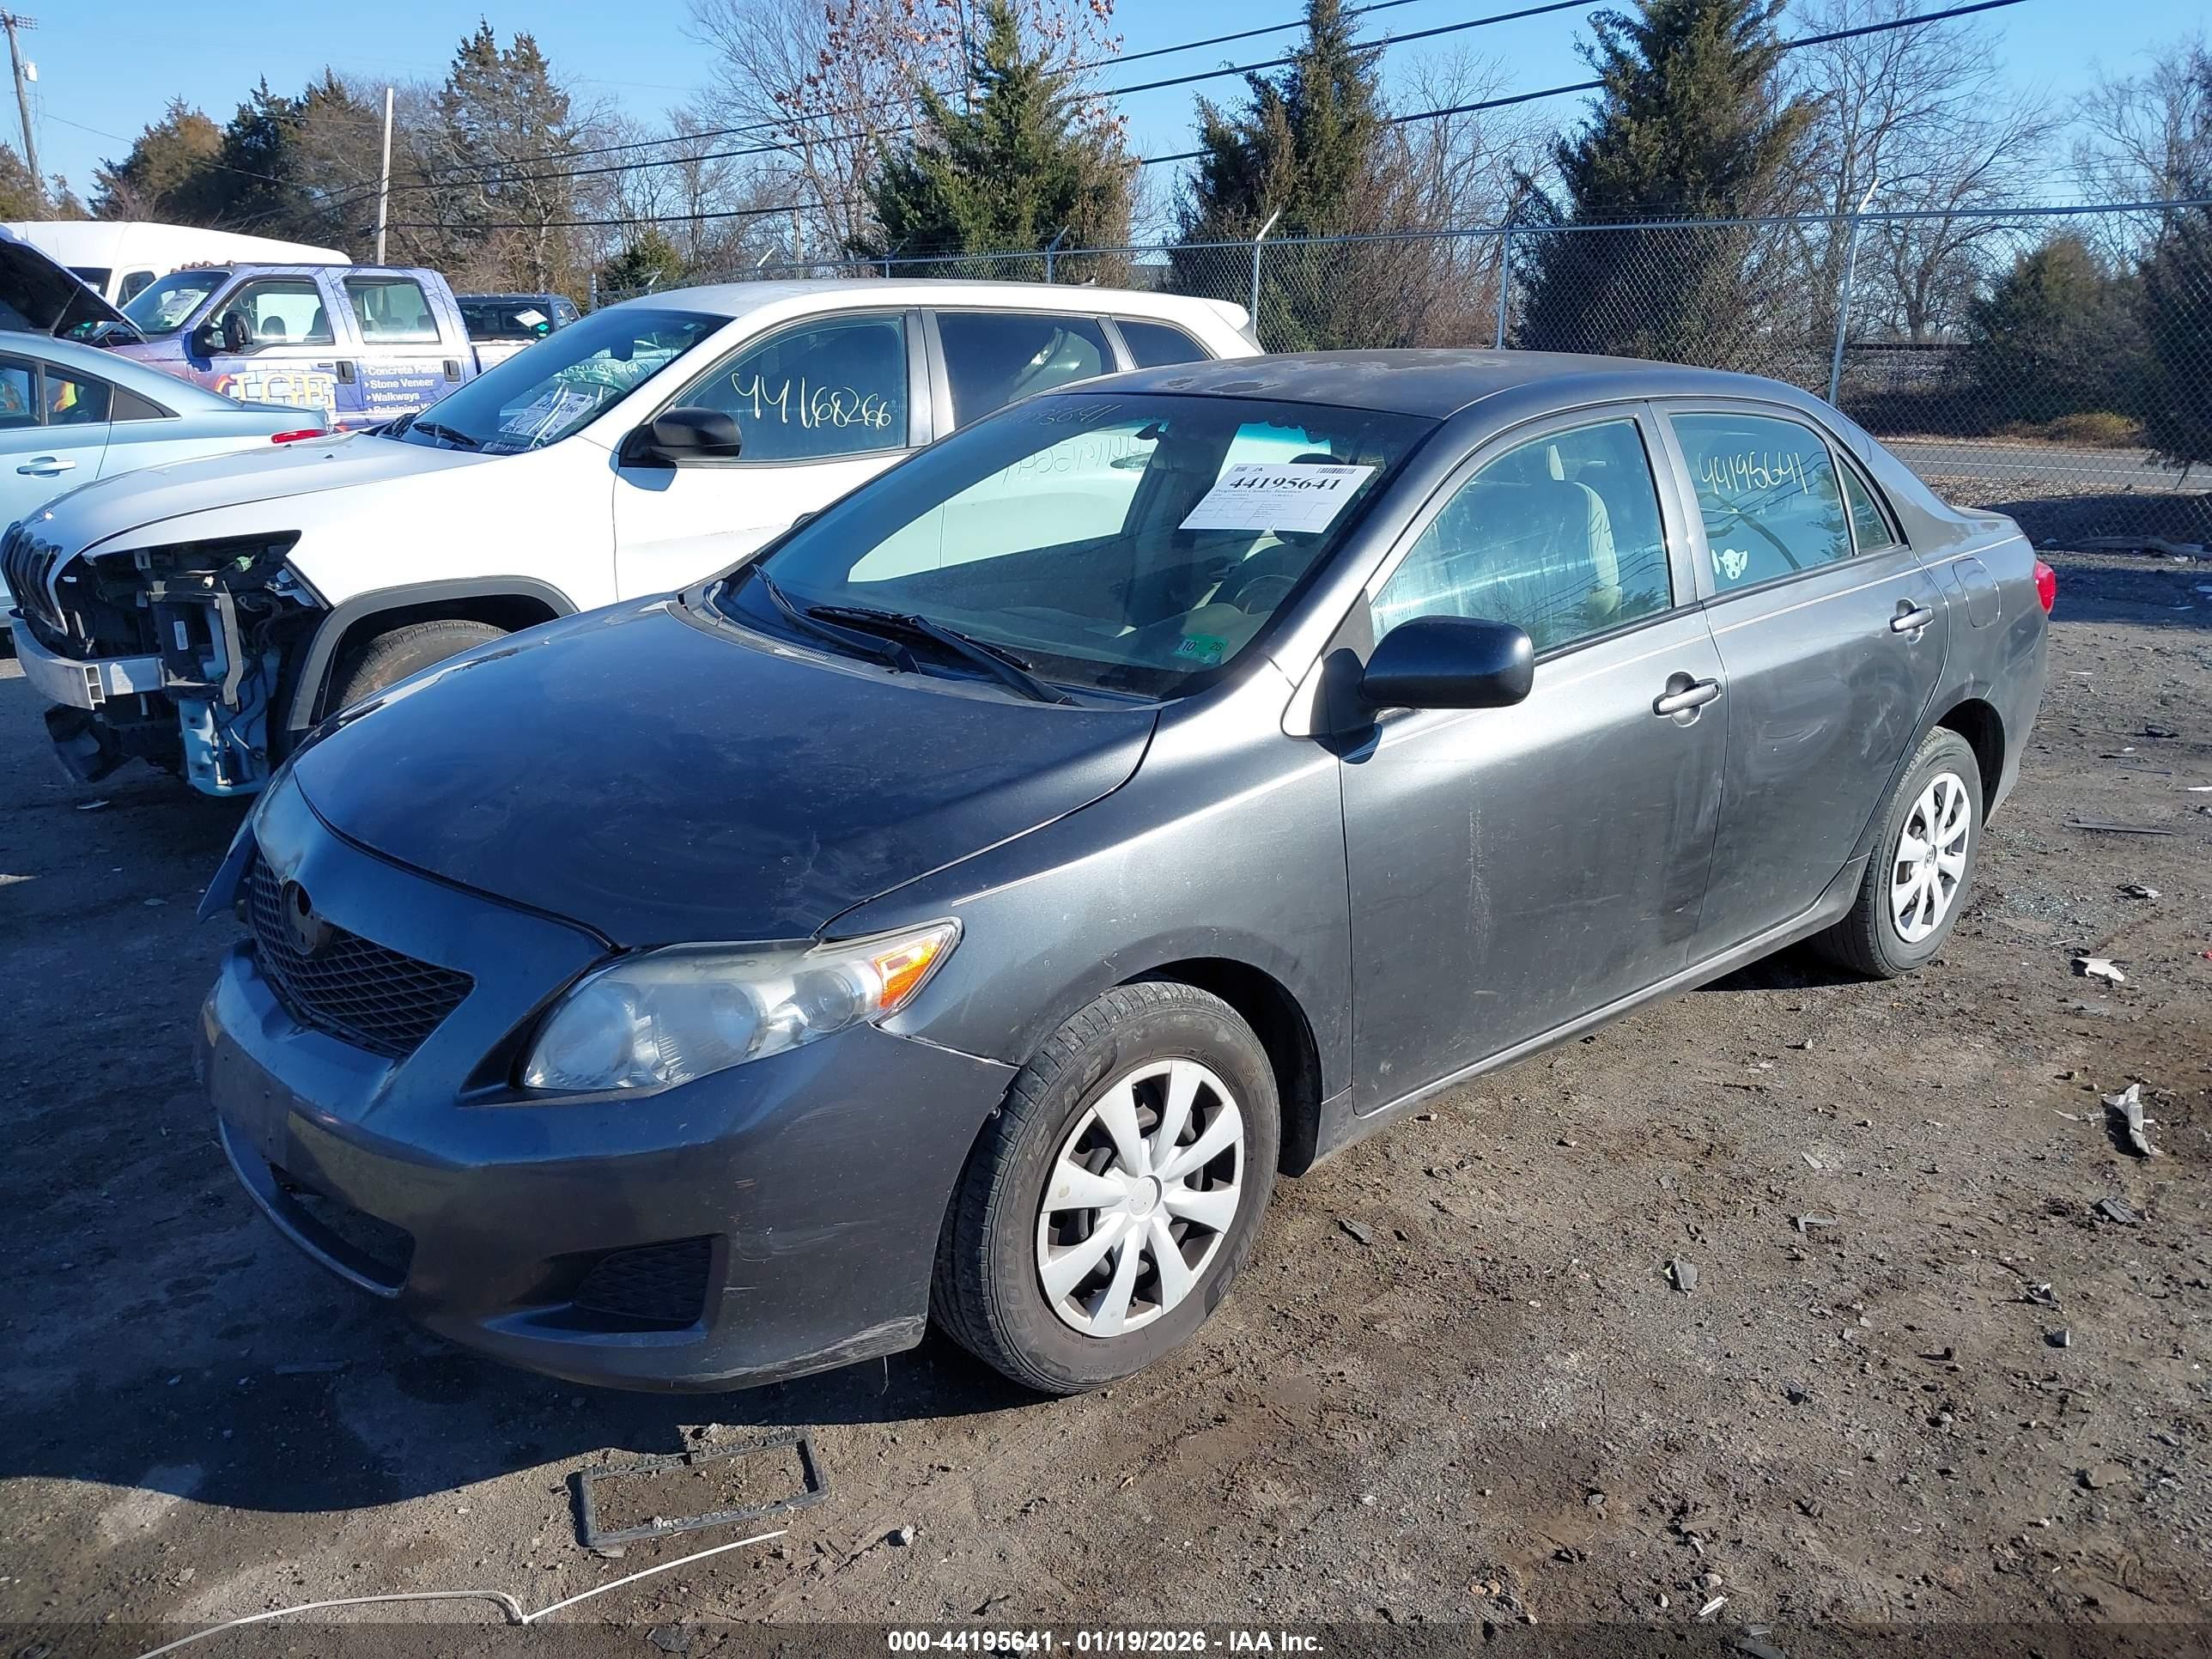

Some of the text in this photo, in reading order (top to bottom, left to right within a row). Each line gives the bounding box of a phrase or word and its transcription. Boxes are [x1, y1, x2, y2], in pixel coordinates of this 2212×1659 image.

[368, 366, 413, 376] Concrete
[370, 378, 434, 389] Stone Veneer
[371, 392, 421, 403] Walkways
[732, 373, 891, 430] 44168266
[1699, 452, 1809, 495] 44195641
[1230, 477, 1341, 489] 44195641
